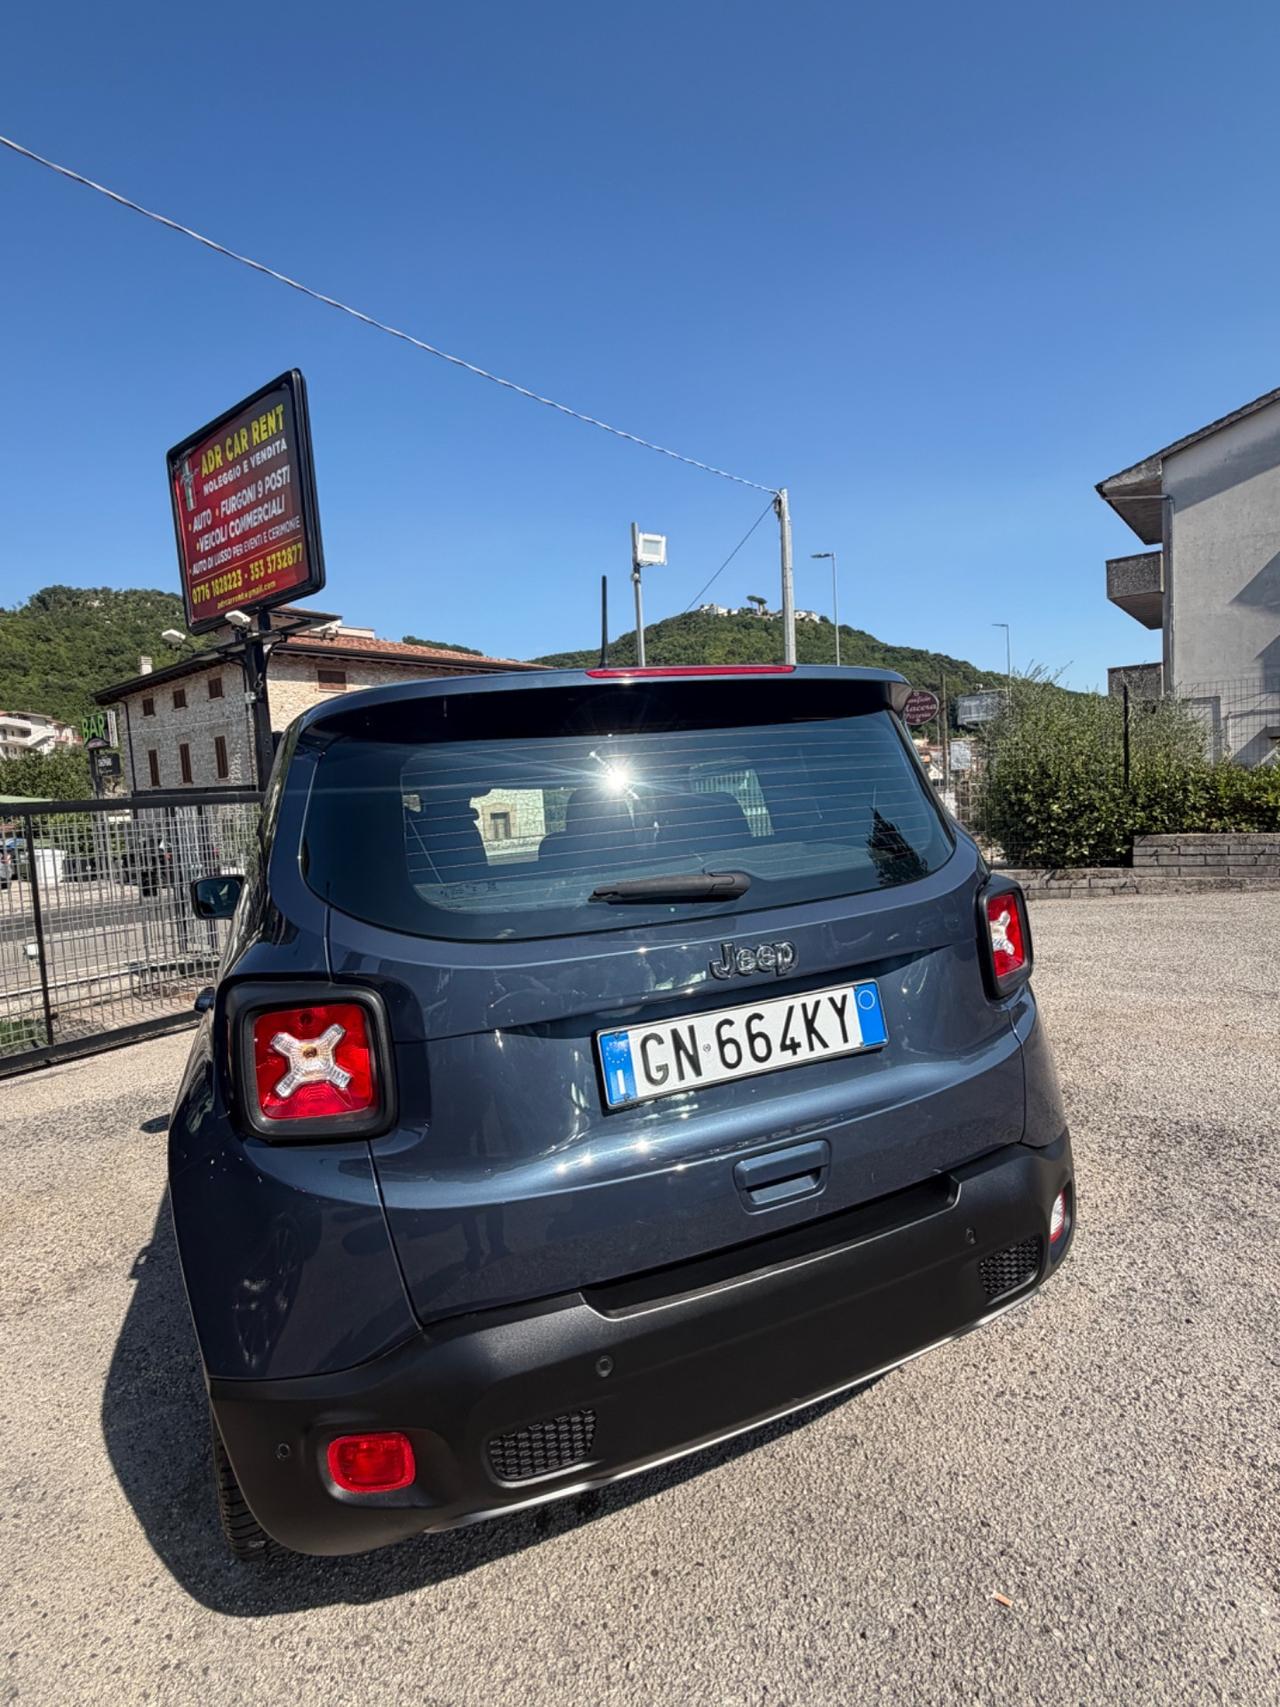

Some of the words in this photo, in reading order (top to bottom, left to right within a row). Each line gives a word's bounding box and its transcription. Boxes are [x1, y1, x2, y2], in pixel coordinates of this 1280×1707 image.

[201, 444, 224, 478] ADR
[225, 427, 248, 461] CAR
[251, 403, 284, 445] RENT
[203, 465, 241, 496] NOLEGGIO
[243, 460, 250, 474] E
[250, 438, 287, 468] VENDITA
[192, 509, 212, 533] AUTO
[220, 483, 257, 518] FURGONI
[257, 479, 264, 498] 9
[264, 464, 290, 494] POSTI
[199, 523, 228, 553] VEICOLI
[228, 494, 285, 538] COMMERCIALI
[191, 583, 210, 604] 0776
[249, 558, 265, 581] 353
[266, 542, 302, 574] 3732877
[192, 559, 207, 575] AUTO
[207, 556, 214, 569] DI
[214, 547, 232, 566] LUSSO
[232, 543, 244, 557] PER
[244, 533, 263, 553] EVENTI
[262, 530, 269, 543] E
[268, 515, 301, 541] CERIMONIE
[82, 713, 106, 744] BAR
[709, 941, 798, 979] Jeep
